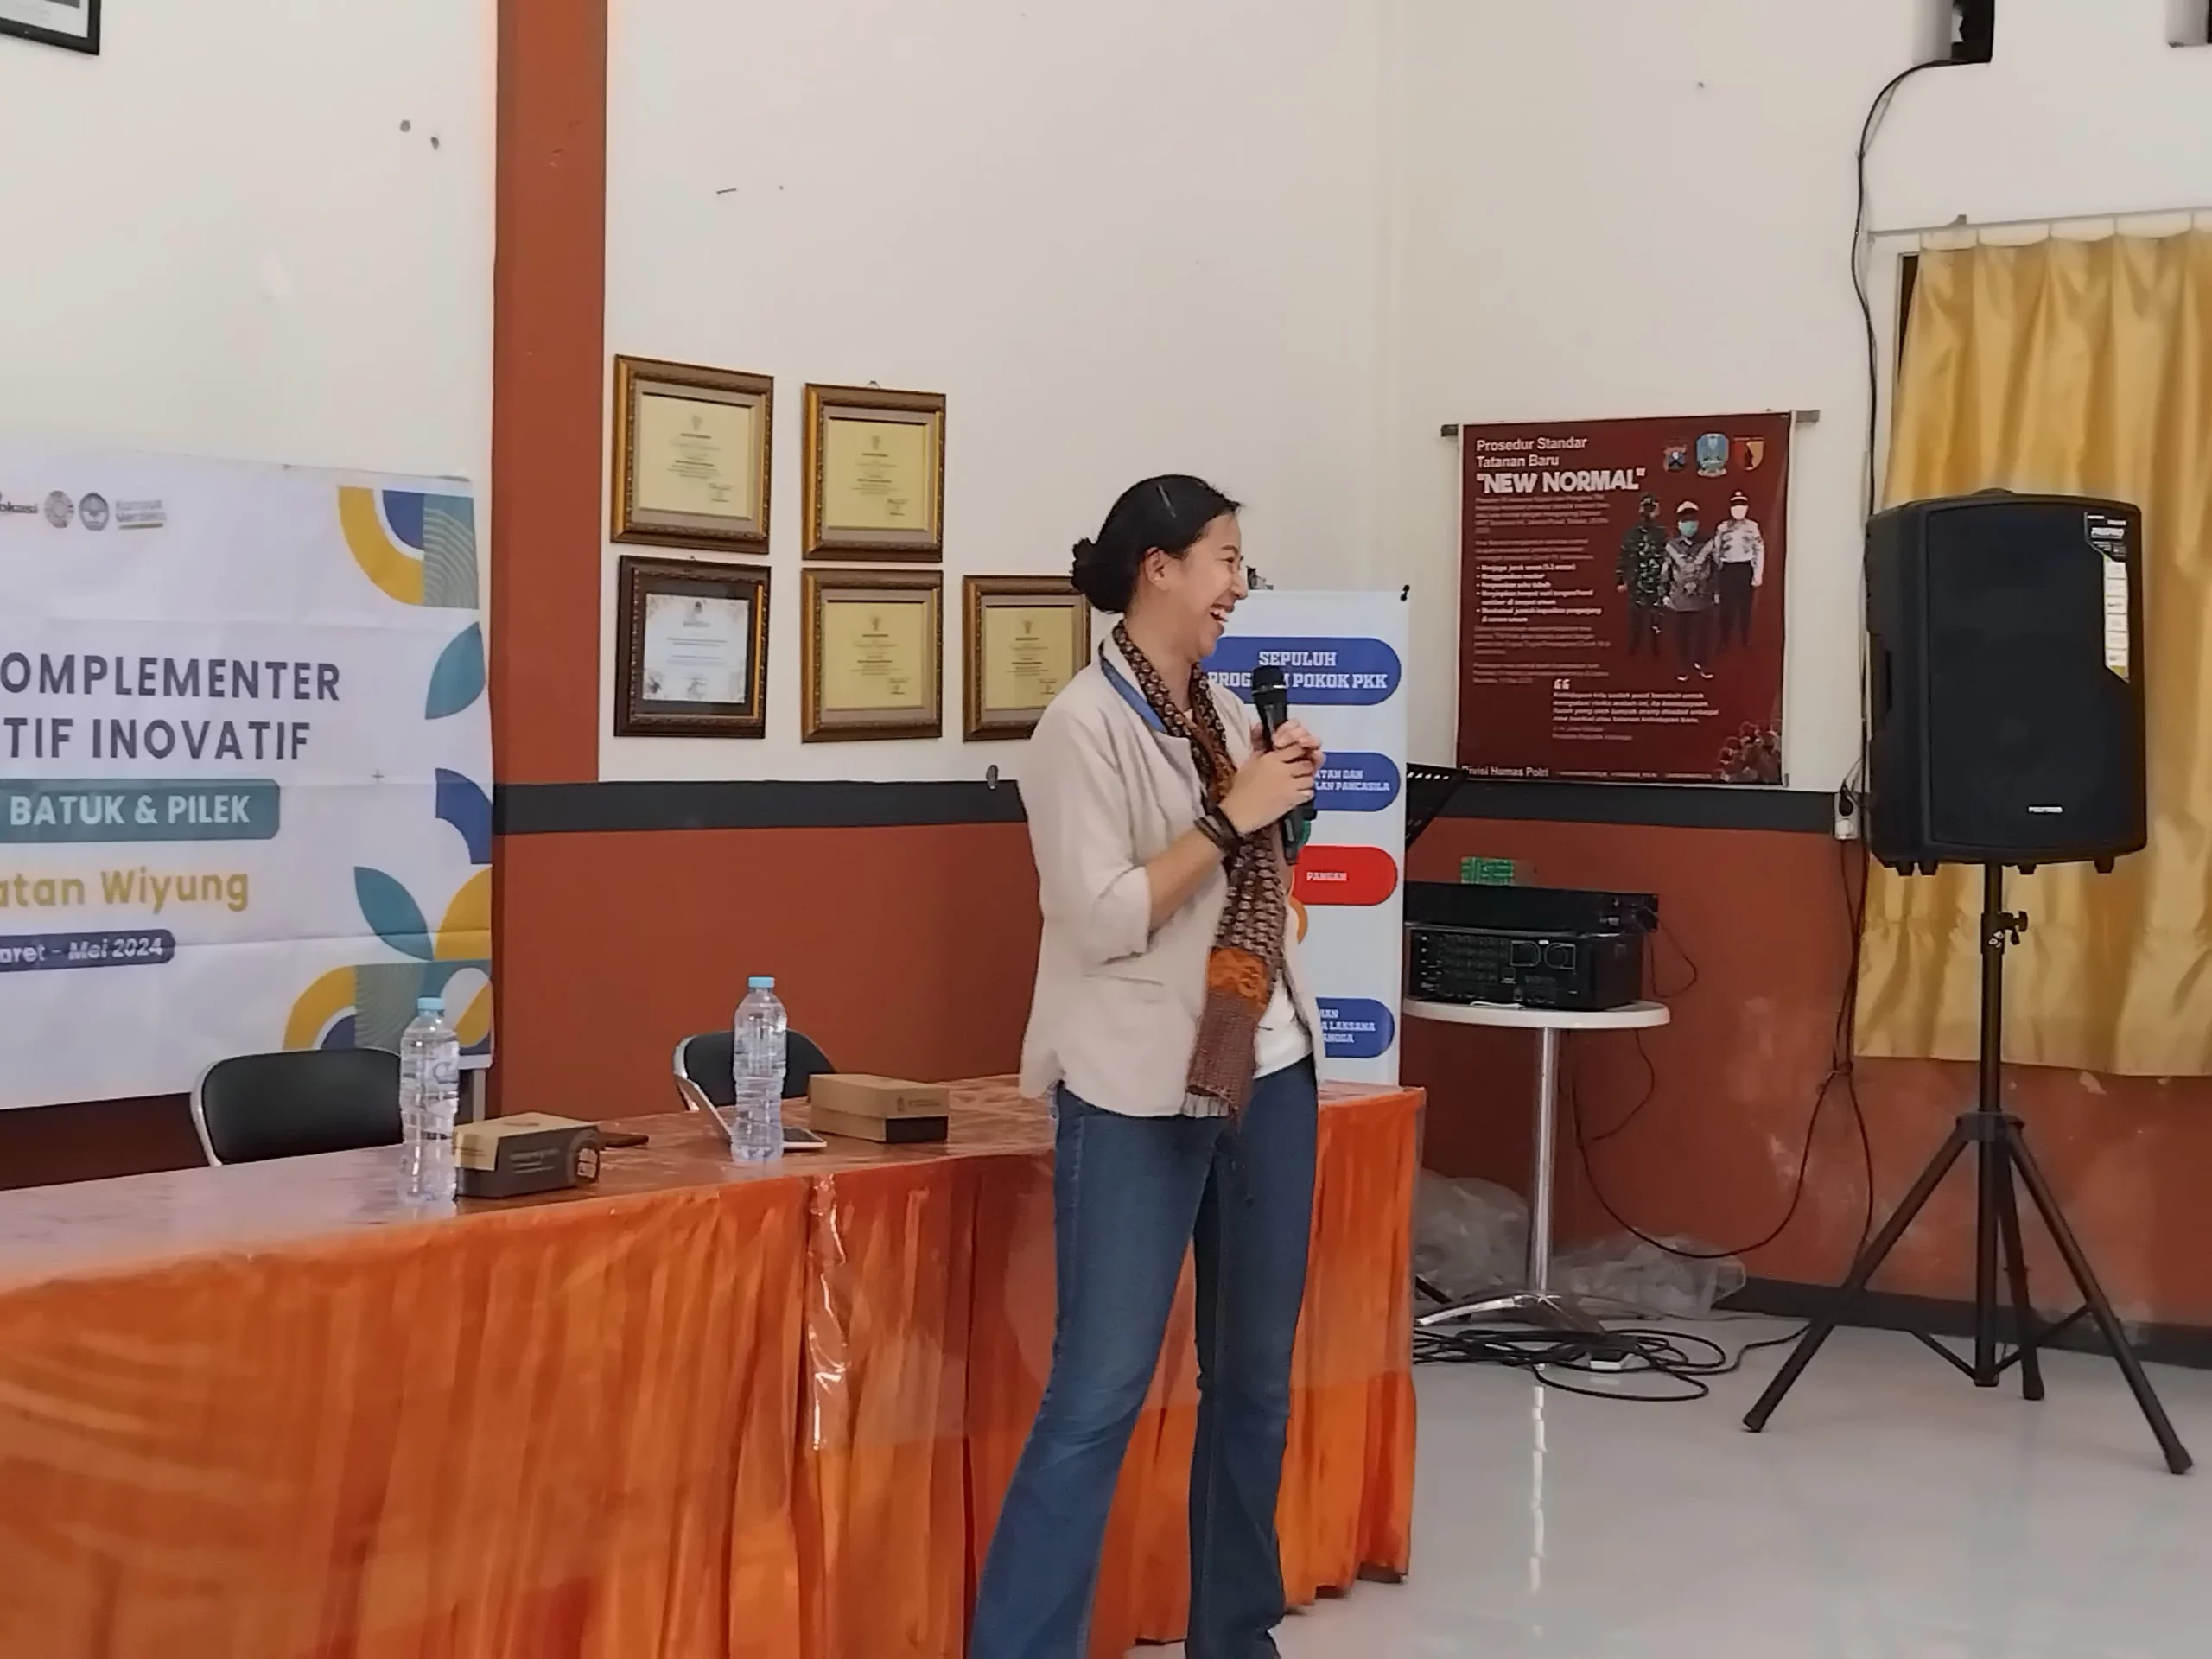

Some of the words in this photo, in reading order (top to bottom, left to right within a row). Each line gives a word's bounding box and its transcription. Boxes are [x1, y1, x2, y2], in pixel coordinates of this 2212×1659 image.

[1476, 439, 1535, 451] Prosedur
[1537, 436, 1587, 449] Standar
[1476, 456, 1525, 467] Tatanan
[1529, 454, 1560, 467] Baru
[1258, 652, 1337, 667] SEPULUH
[1293, 673, 1351, 689] POKOK
[1352, 673, 1388, 689] PKK
[3, 717, 74, 759] TIF
[92, 718, 311, 760] INOVATIF
[10, 795, 126, 826] BATUK
[134, 794, 158, 824] &
[168, 794, 251, 824] PILEK
[100, 865, 249, 915] Wiyung
[68, 938, 107, 960] Mei
[112, 938, 164, 958] 2024
